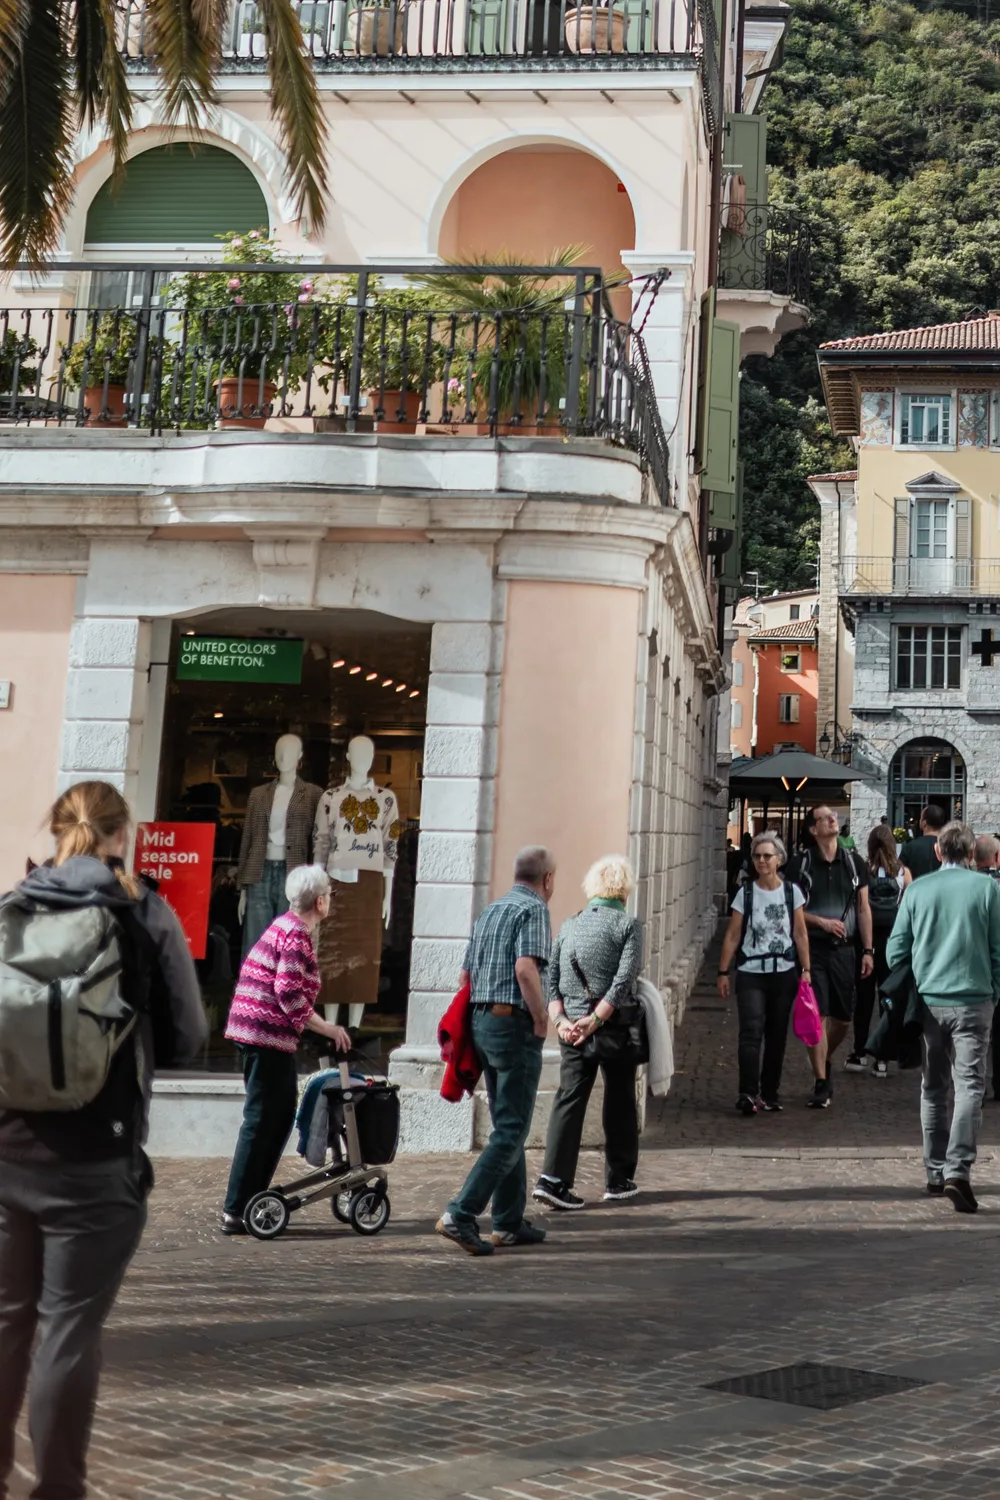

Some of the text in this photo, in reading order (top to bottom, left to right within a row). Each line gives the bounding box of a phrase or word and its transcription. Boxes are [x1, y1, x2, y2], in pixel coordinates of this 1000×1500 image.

[183, 641, 277, 655] UNITED COLORS
[181, 653, 265, 667] OF BENETTON.
[142, 831, 175, 847] Mid
[141, 851, 199, 864] season
